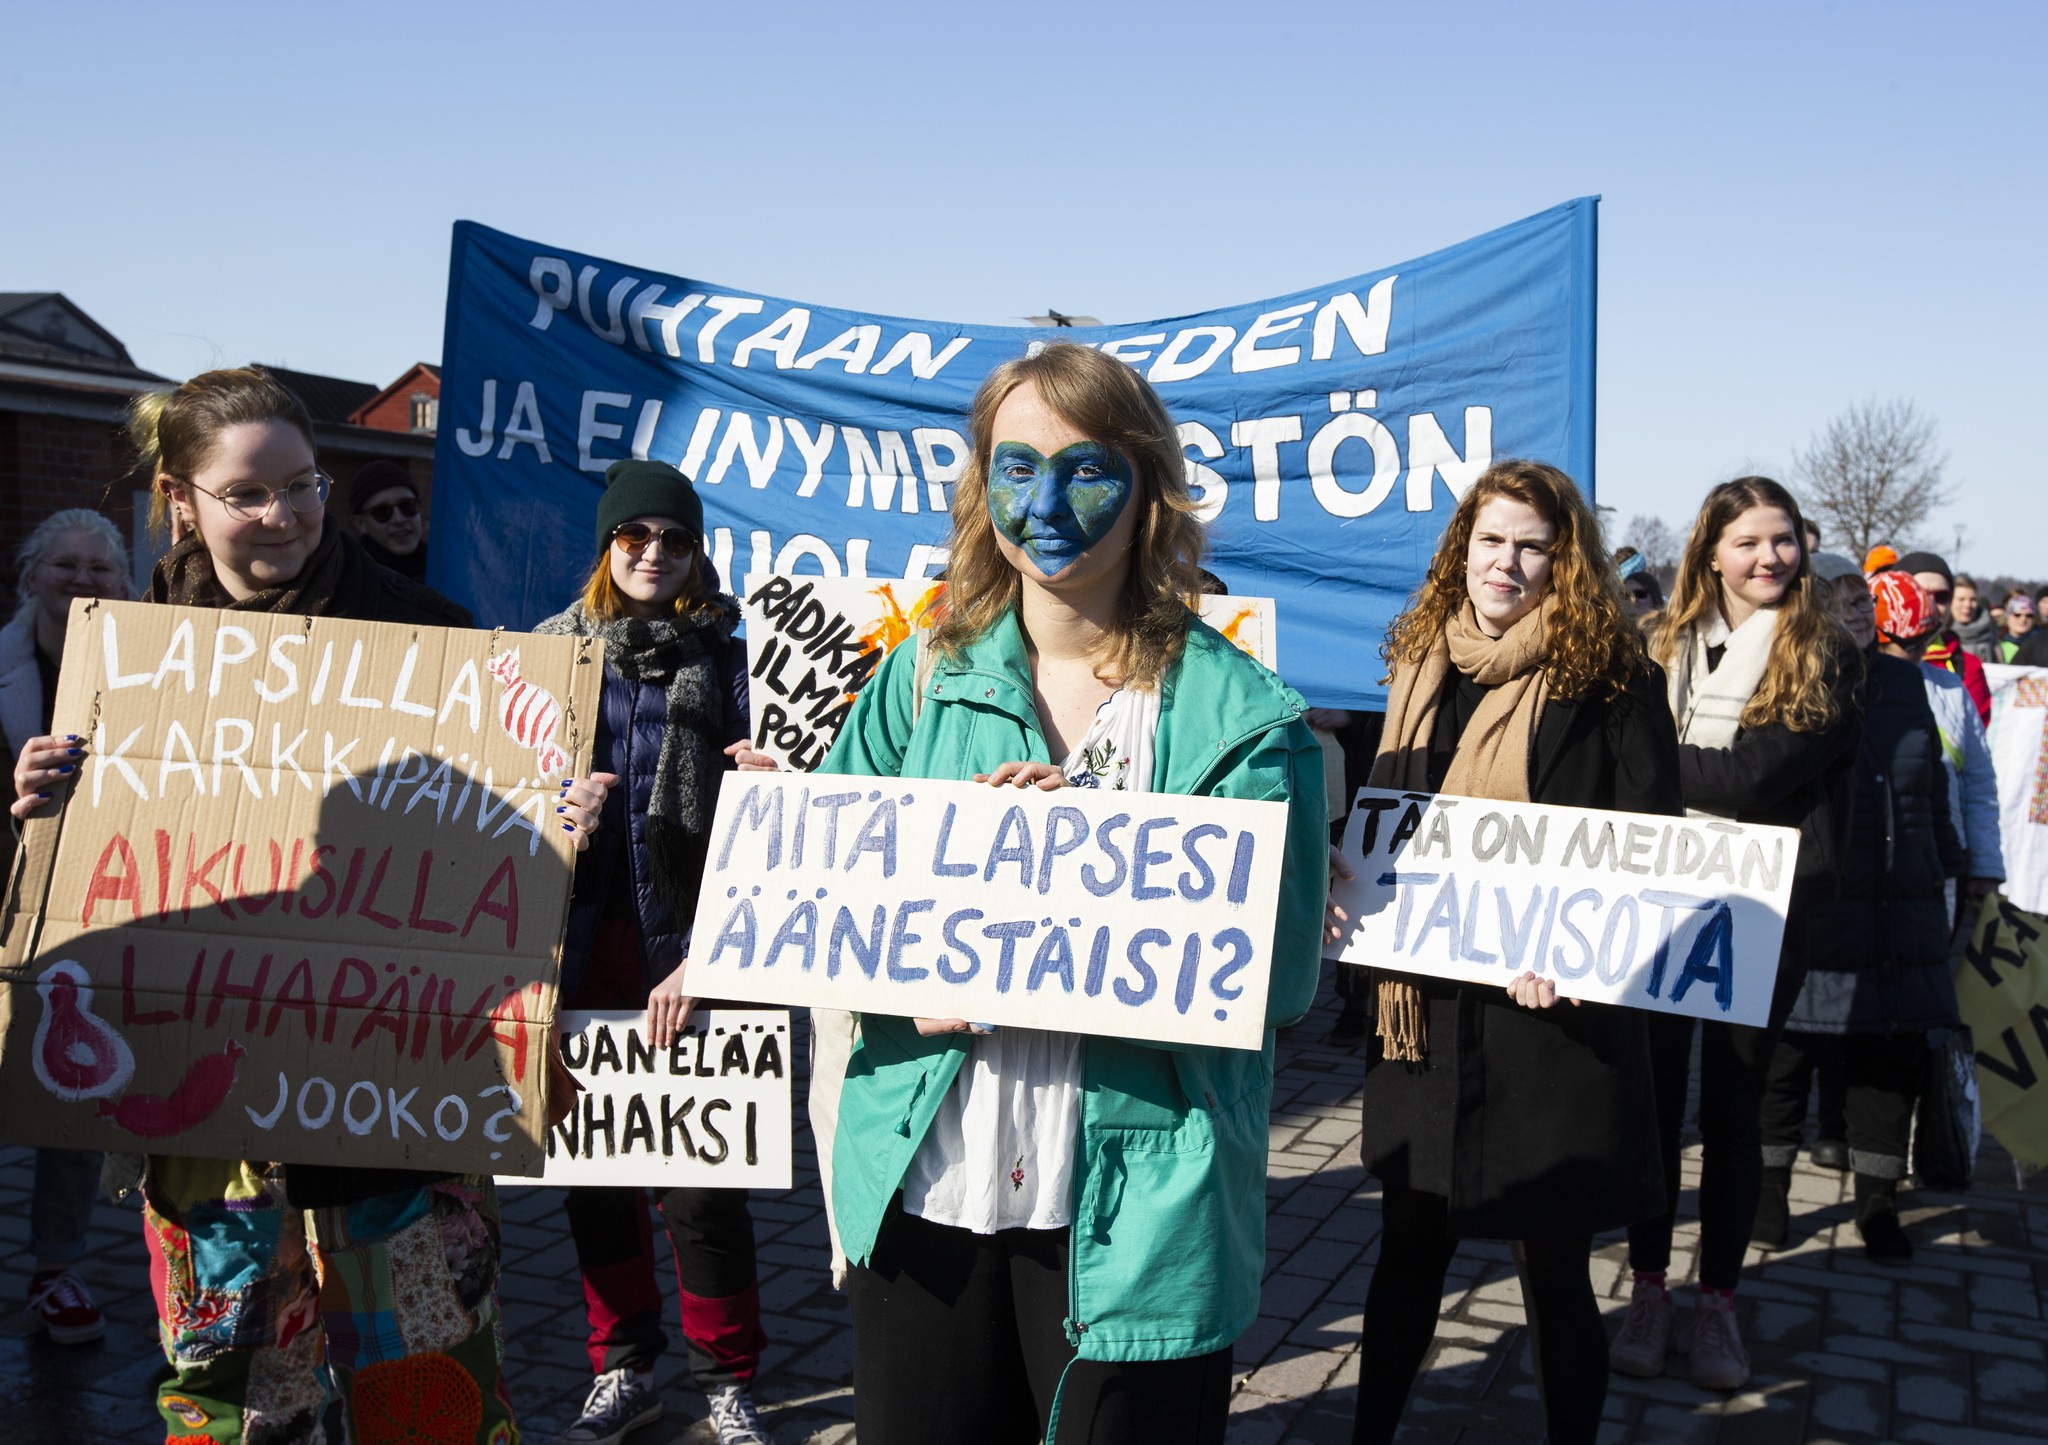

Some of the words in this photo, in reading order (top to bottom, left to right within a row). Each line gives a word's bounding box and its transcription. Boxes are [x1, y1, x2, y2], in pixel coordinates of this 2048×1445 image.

[529, 256, 972, 379] PUHTAAN
[1024, 274, 1398, 383] EDEN
[455, 379, 553, 464] JA
[103, 611, 482, 734] LAPSILLA
[92, 717, 561, 857] KARKKIPÄIVÄ
[716, 784, 915, 879] MITÄ
[932, 801, 1255, 908] LAPSESI
[82, 829, 520, 951] AIKUISILLA
[1472, 811, 1549, 865] ON
[1560, 817, 1784, 892] MEIDÄN
[707, 885, 1255, 1022] ÄÄNESTÄISI?
[1376, 871, 1733, 1012] TALVISOTA
[121, 945, 543, 1084] LIHAPÄIVÄ
[669, 1023, 786, 1079] ELÄÄ
[245, 1072, 523, 1161] JOOKO?
